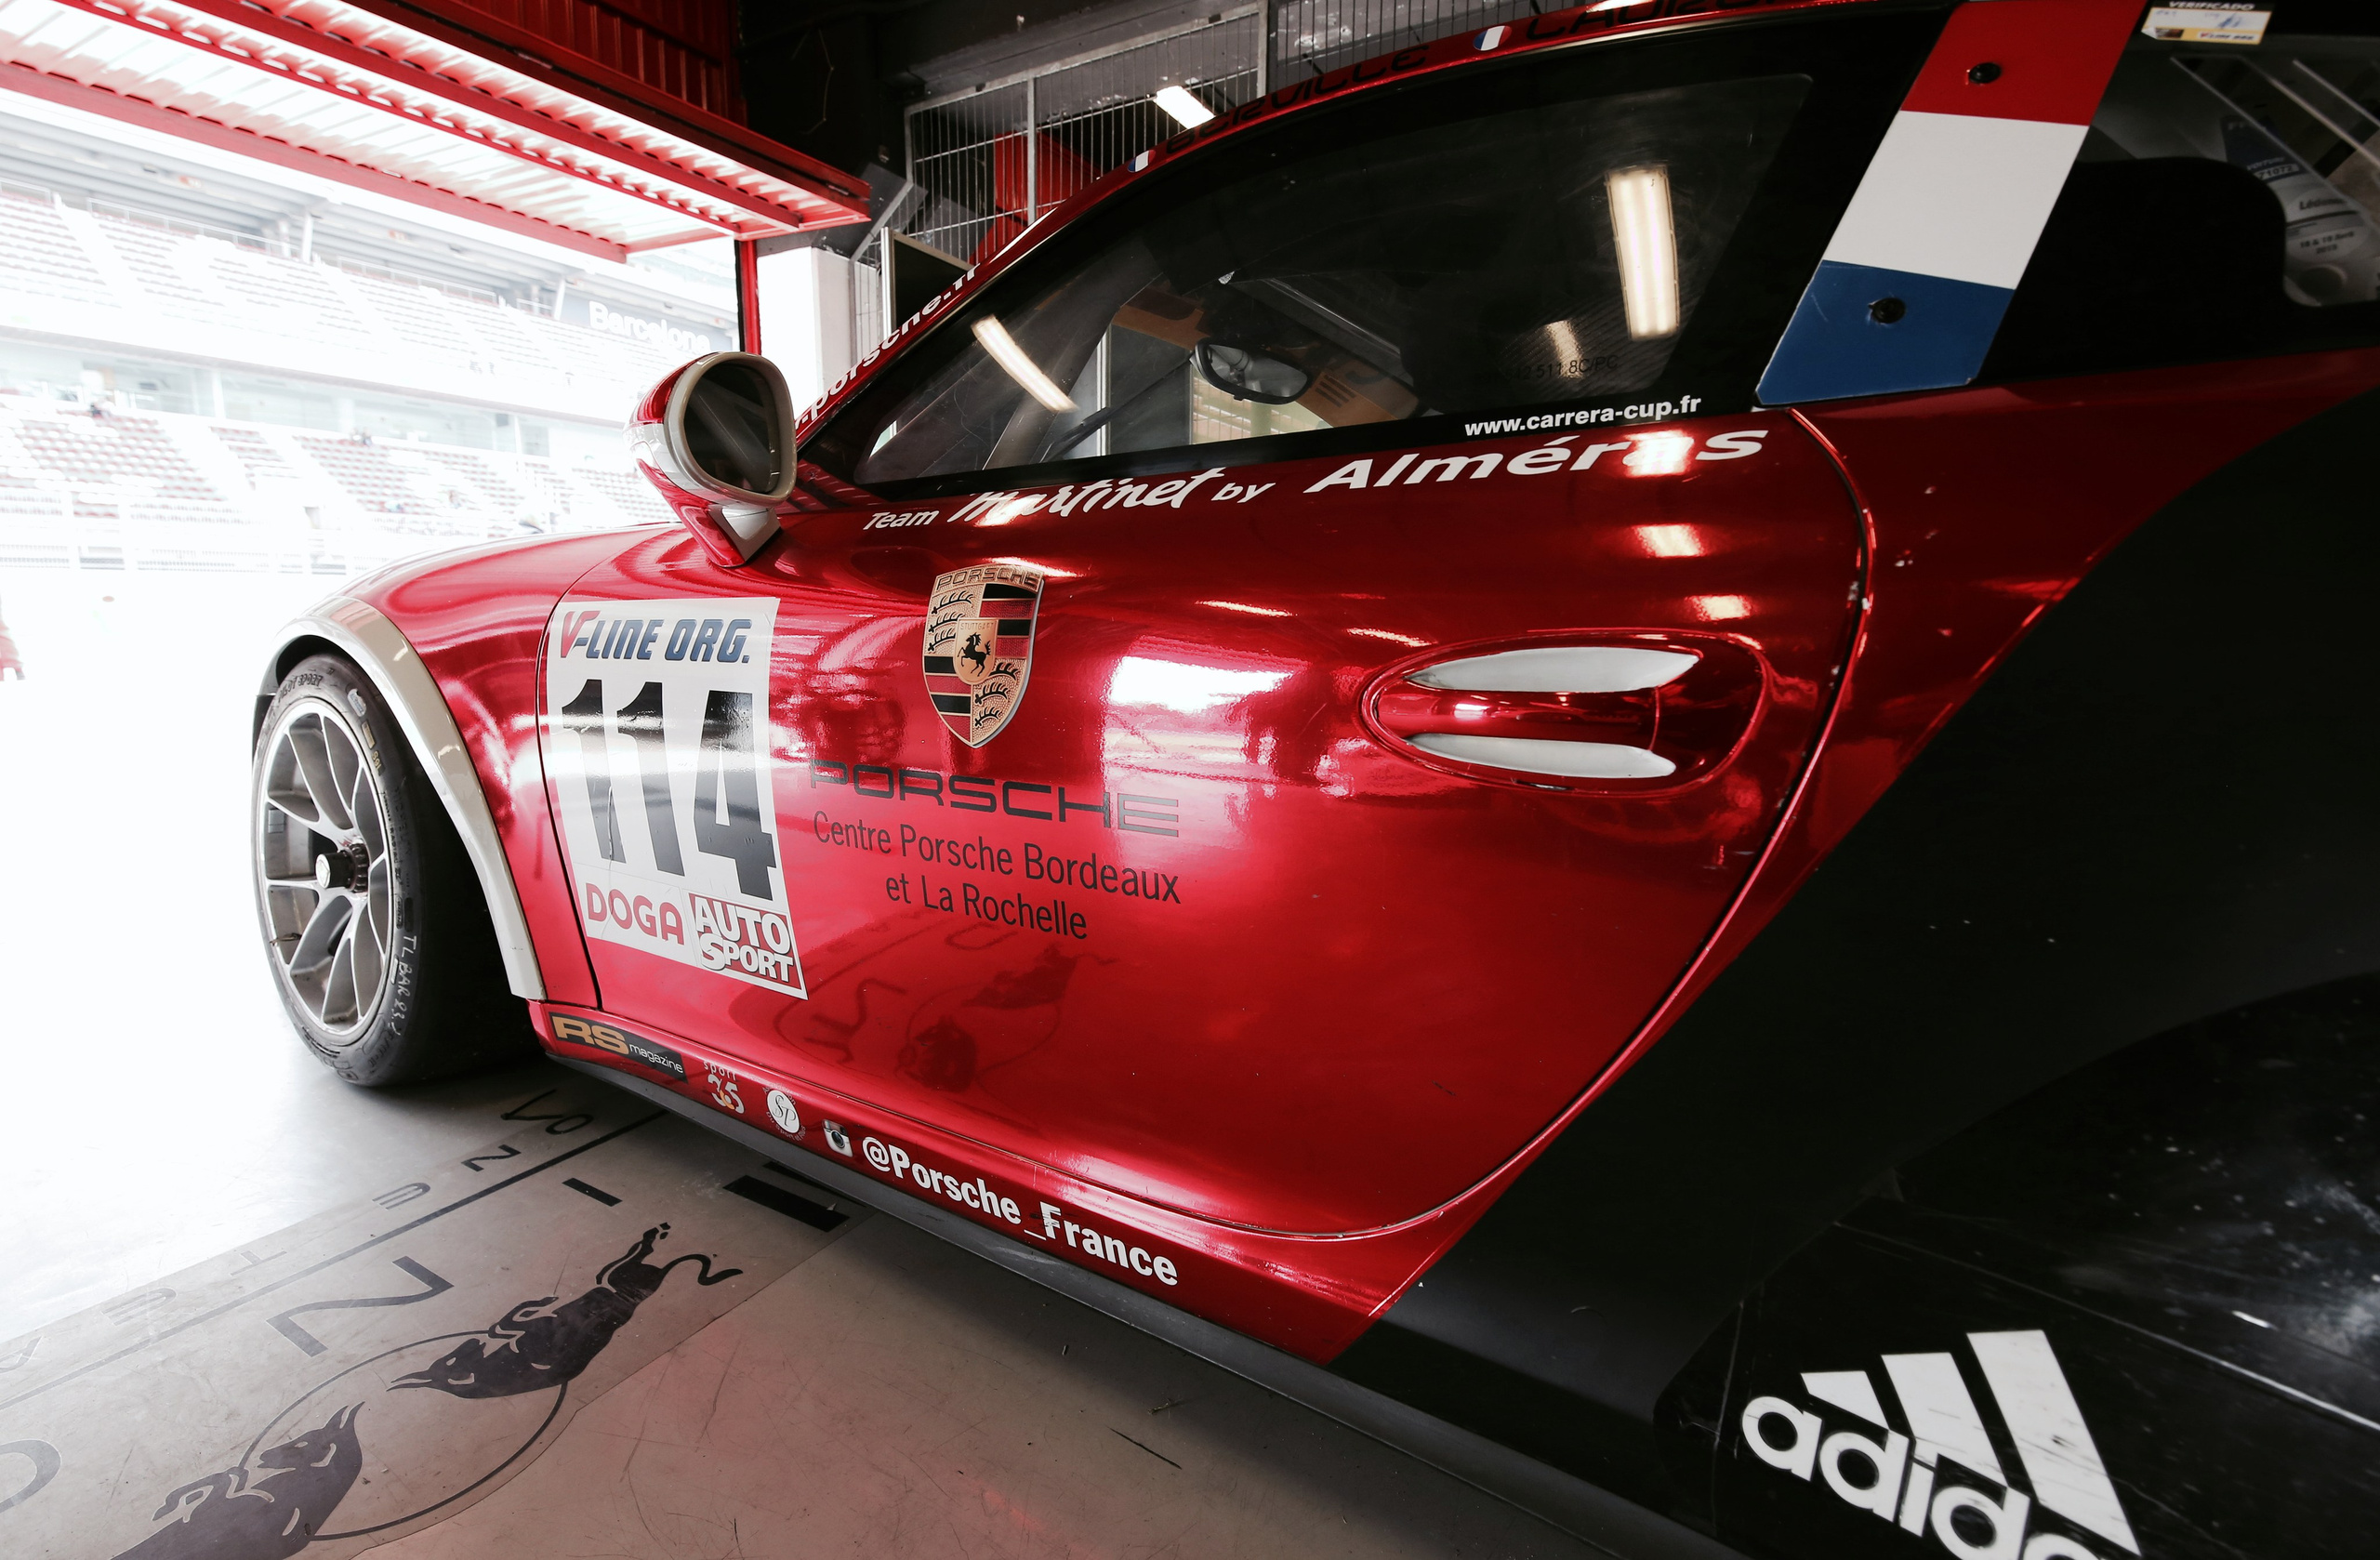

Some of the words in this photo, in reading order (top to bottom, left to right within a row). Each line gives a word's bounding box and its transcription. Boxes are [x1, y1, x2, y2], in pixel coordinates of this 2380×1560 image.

[2169, 1, 2256, 10] VERIFICADO
[588, 300, 713, 352] Barcelona
[1464, 394, 1702, 436] www.carrera-cup.fr
[863, 509, 940, 531] Team
[1210, 482, 1276, 504] by
[936, 566, 1041, 591] PORSCHE
[664, 618, 753, 664] ORG.
[561, 678, 777, 902] 114
[810, 759, 1179, 838] PORSCHE
[813, 810, 892, 854] Centre
[900, 824, 1013, 876] Porsche
[1025, 843, 1182, 905] Bordeaux
[585, 882, 685, 946] DOGA
[693, 895, 793, 957] AUTO
[886, 874, 911, 905] et
[921, 875, 955, 914] La
[963, 884, 1089, 940] Rochelle
[699, 932, 797, 984] SPORT
[551, 1016, 629, 1055] RS
[629, 1041, 684, 1075] magazine
[861, 1136, 1179, 1287] @Porsche_France
